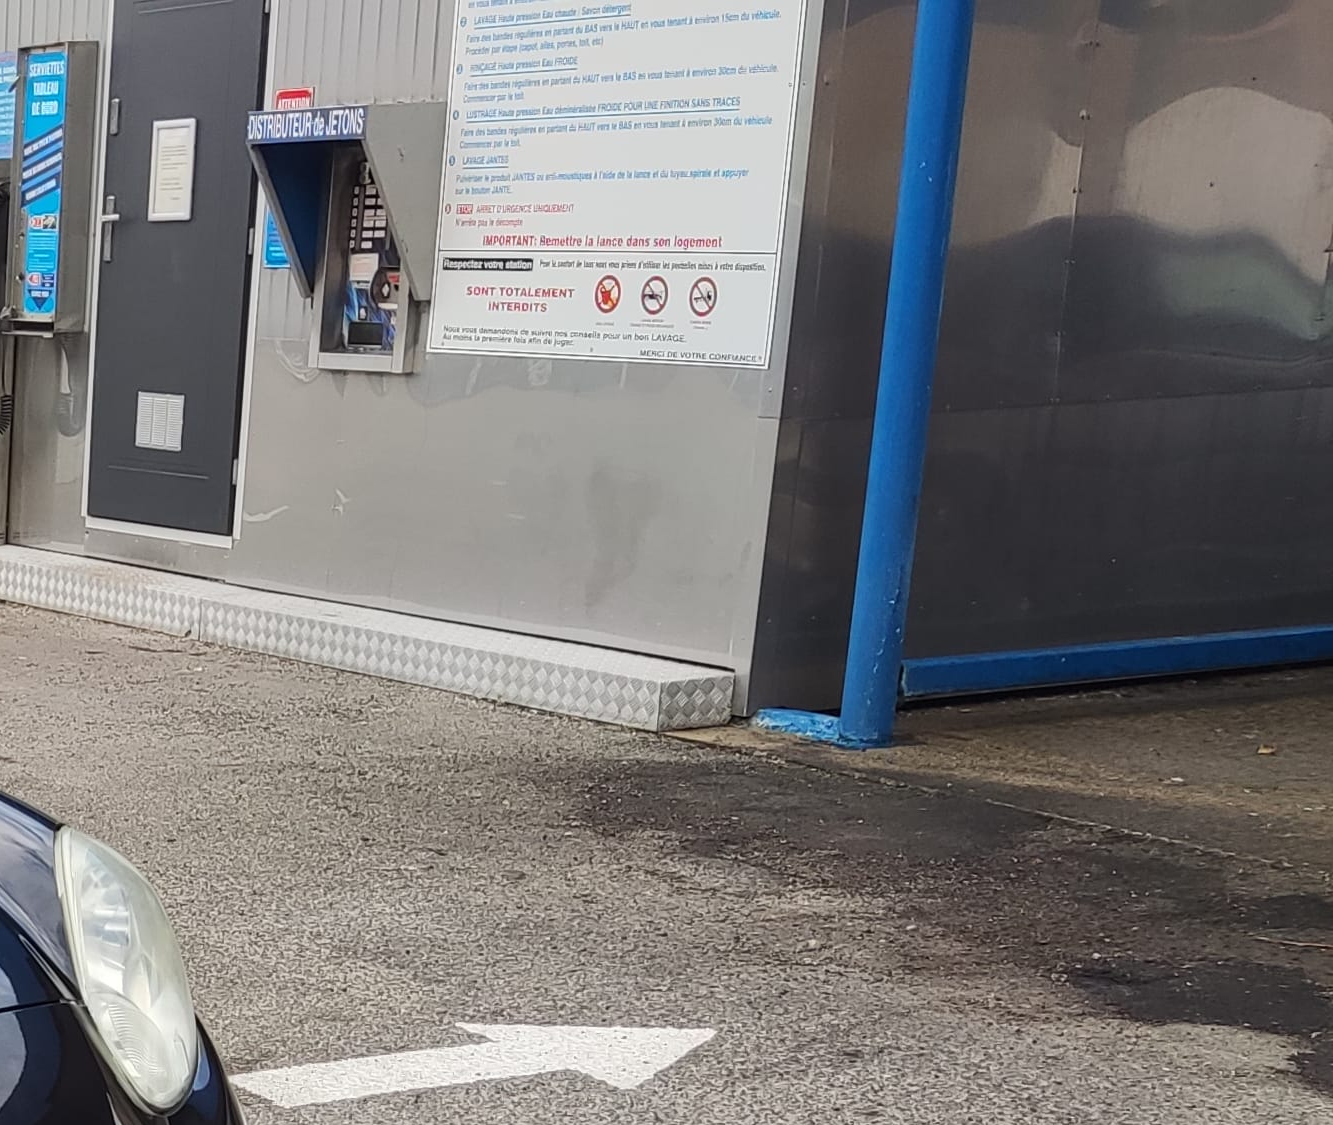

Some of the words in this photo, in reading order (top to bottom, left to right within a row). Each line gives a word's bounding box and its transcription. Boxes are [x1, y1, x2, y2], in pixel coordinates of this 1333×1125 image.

[585, 23, 598, 33] BAS
[621, 20, 640, 30] HAUT
[248, 111, 312, 140] DISTRIBUTEUR
[313, 113, 324, 133] de
[325, 108, 364, 136] JETONS
[483, 235, 537, 246] IMPORTANT:
[540, 235, 581, 246] Remettre
[585, 235, 593, 246] la
[597, 235, 623, 247] lance
[626, 235, 650, 247] dans
[653, 237, 670, 247] son
[674, 235, 722, 250] logement
[466, 287, 496, 296] SONT
[500, 287, 575, 298] TOTALEMENT
[488, 302, 548, 313] INTERDITS
